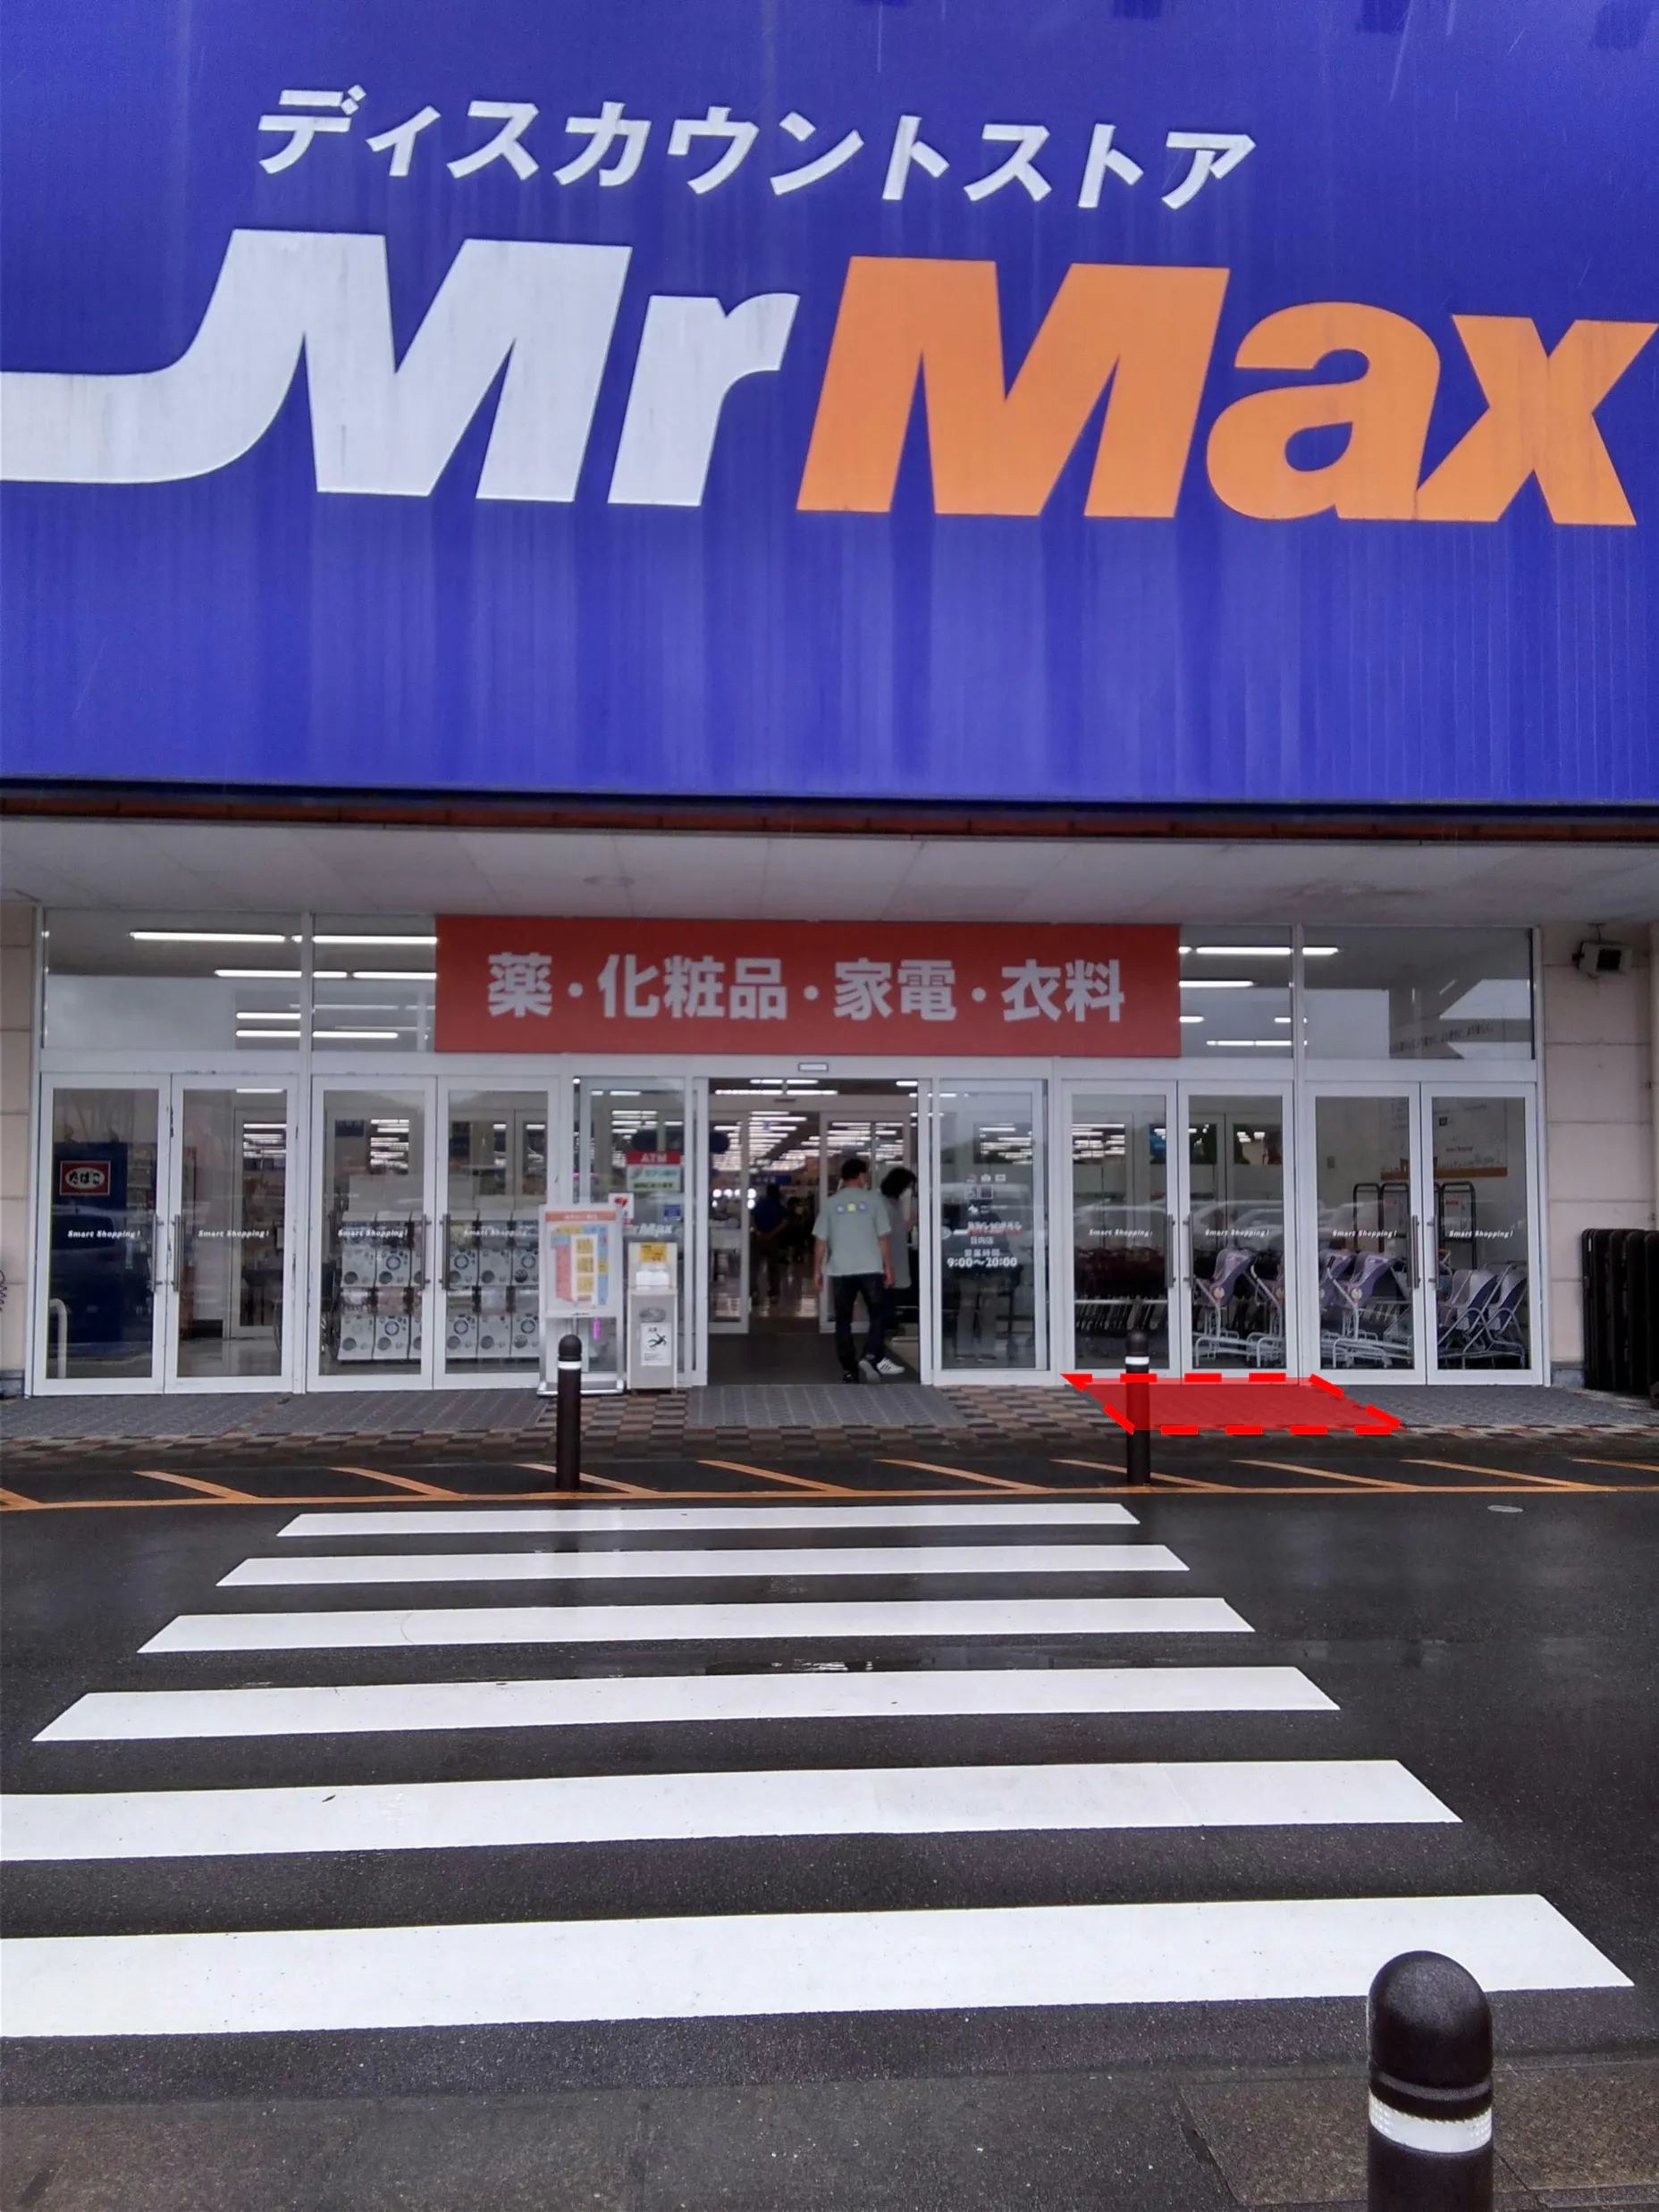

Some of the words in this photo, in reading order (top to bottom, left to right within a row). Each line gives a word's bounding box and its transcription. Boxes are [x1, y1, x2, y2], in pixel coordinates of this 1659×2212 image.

[257, 84, 1256, 210] ディスカウントストア
[640, 1152, 668, 1164] ATM
[68, 1169, 101, 1184] たばこ
[67, 1229, 94, 1239] Smart
[97, 1229, 141, 1240] Shopping!
[198, 1229, 224, 1238] Smart
[226, 1229, 270, 1239] Shopping!
[338, 1228, 364, 1237] Smart
[366, 1228, 408, 1238] Shopping!
[1089, 1228, 1112, 1236] Smart
[1115, 1228, 1153, 1237] Shopping!
[1205, 1228, 1228, 1237] Smart
[1231, 1228, 1270, 1238] Shopping!
[1332, 1229, 1356, 1238] Smart
[1358, 1229, 1397, 1238] Shopping!
[1448, 1229, 1472, 1238] Smart
[1475, 1229, 1513, 1239] Shopping!
